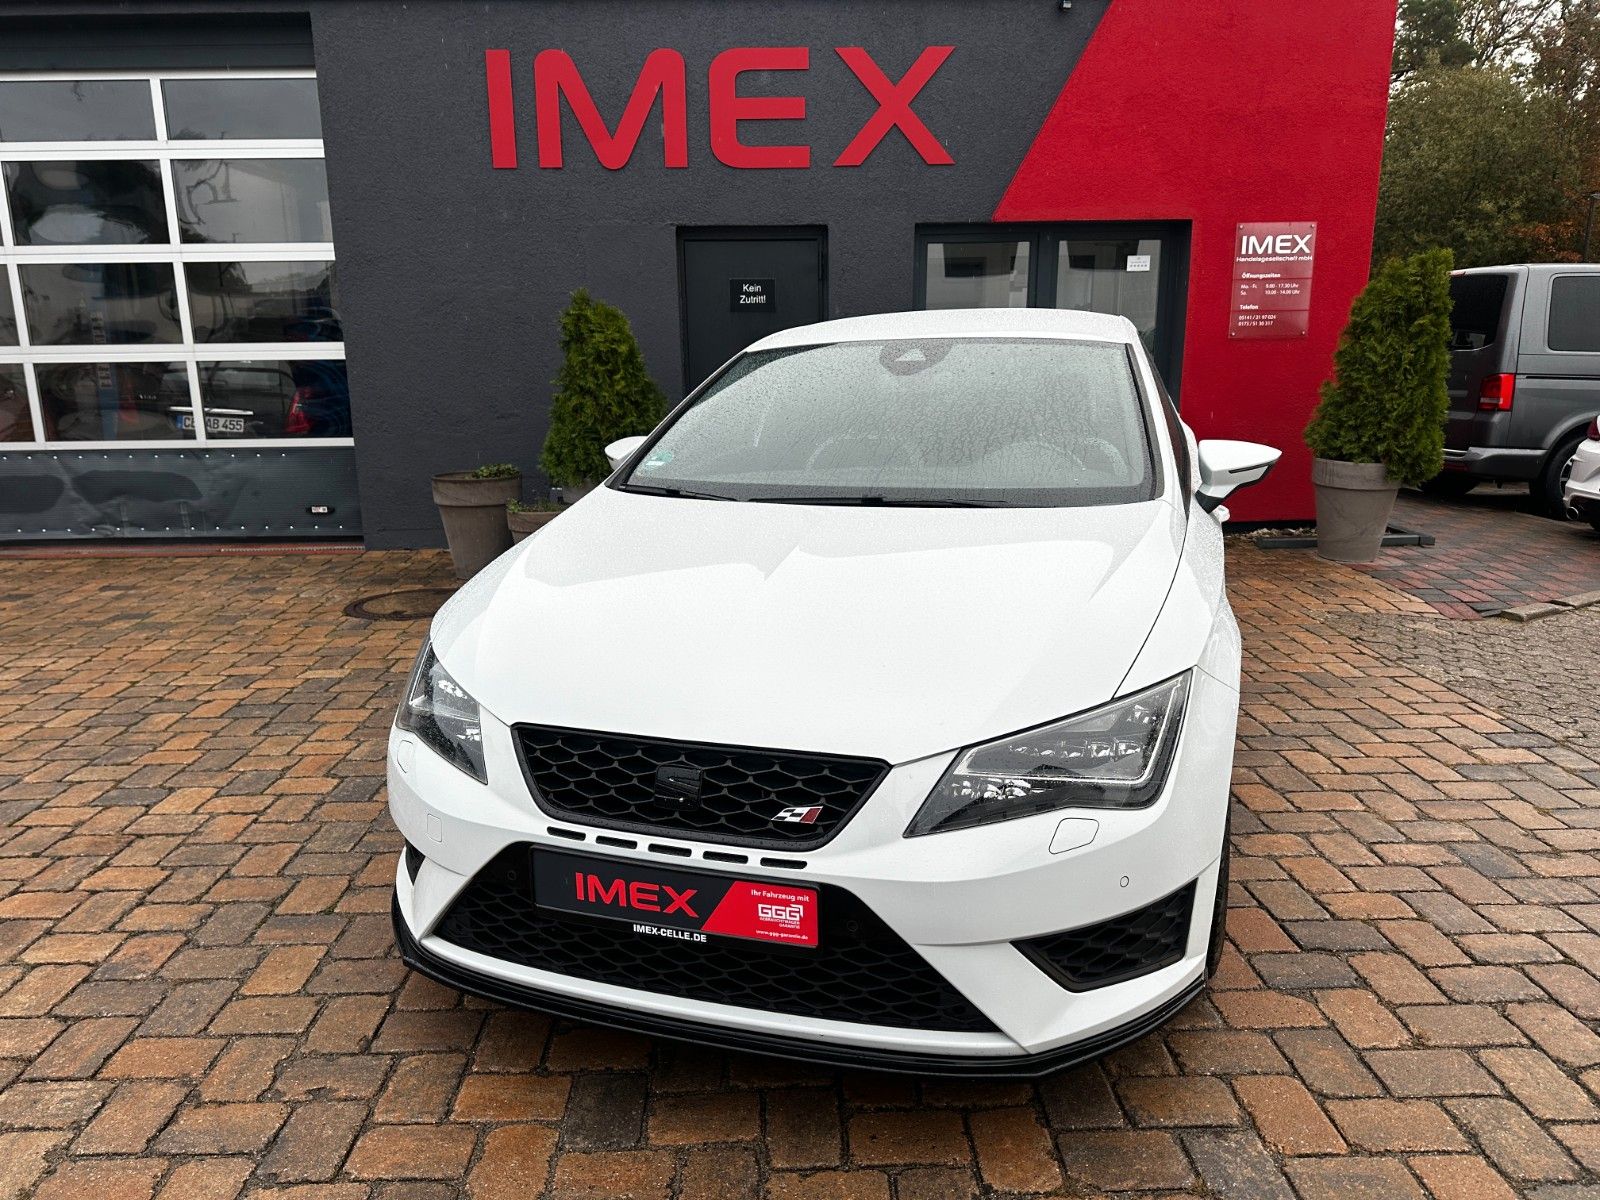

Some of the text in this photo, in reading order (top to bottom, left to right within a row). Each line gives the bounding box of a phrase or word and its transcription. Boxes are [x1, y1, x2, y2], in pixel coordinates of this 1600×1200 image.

[485, 45, 956, 170] IMEX
[1241, 234, 1313, 255] IMEX
[742, 283, 762, 292] Kein
[739, 295, 766, 304] Zutritt!
[206, 418, 219, 429] AB
[222, 419, 242, 431] 455
[574, 871, 700, 919] IMEX
[762, 890, 796, 902] Fahrzeug
[757, 903, 803, 921] GGG
[633, 923, 708, 943] IMEX-CELLE.DE
